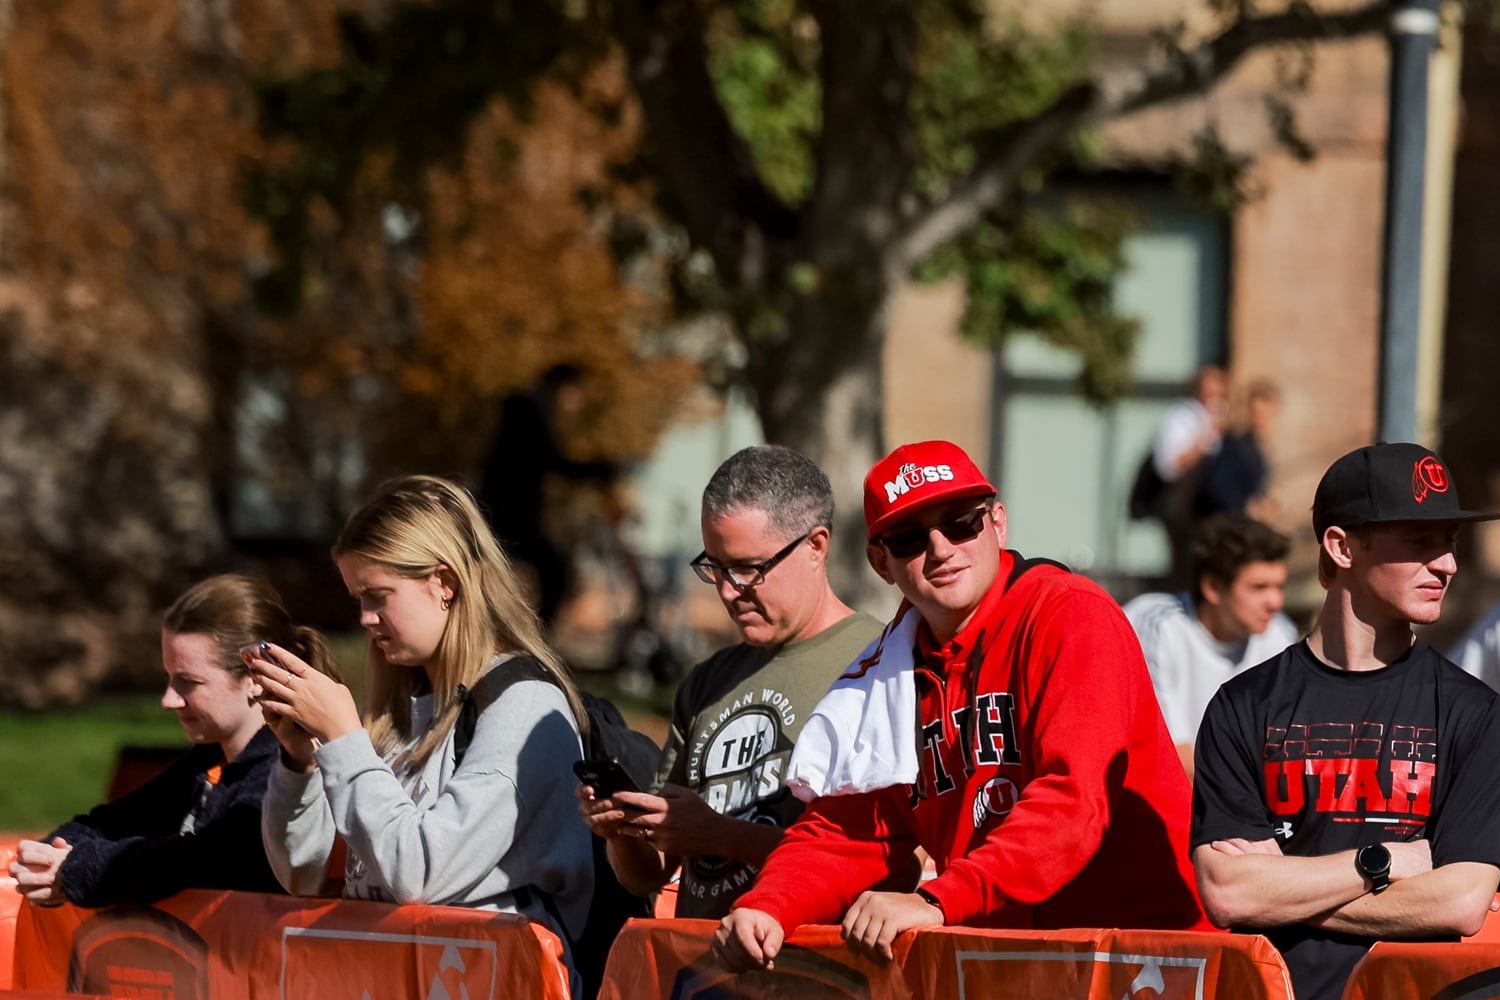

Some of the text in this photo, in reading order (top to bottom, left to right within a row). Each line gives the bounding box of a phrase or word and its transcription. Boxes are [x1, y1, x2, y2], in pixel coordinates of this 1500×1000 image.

[884, 465, 954, 504] MUSS
[1424, 463, 1444, 487] U
[689, 688, 795, 780] HUNTSMAN WORLD
[722, 731, 766, 769] THE
[908, 692, 1022, 811] TH
[1264, 758, 1436, 817] UTAH
[711, 864, 759, 897] GAME
